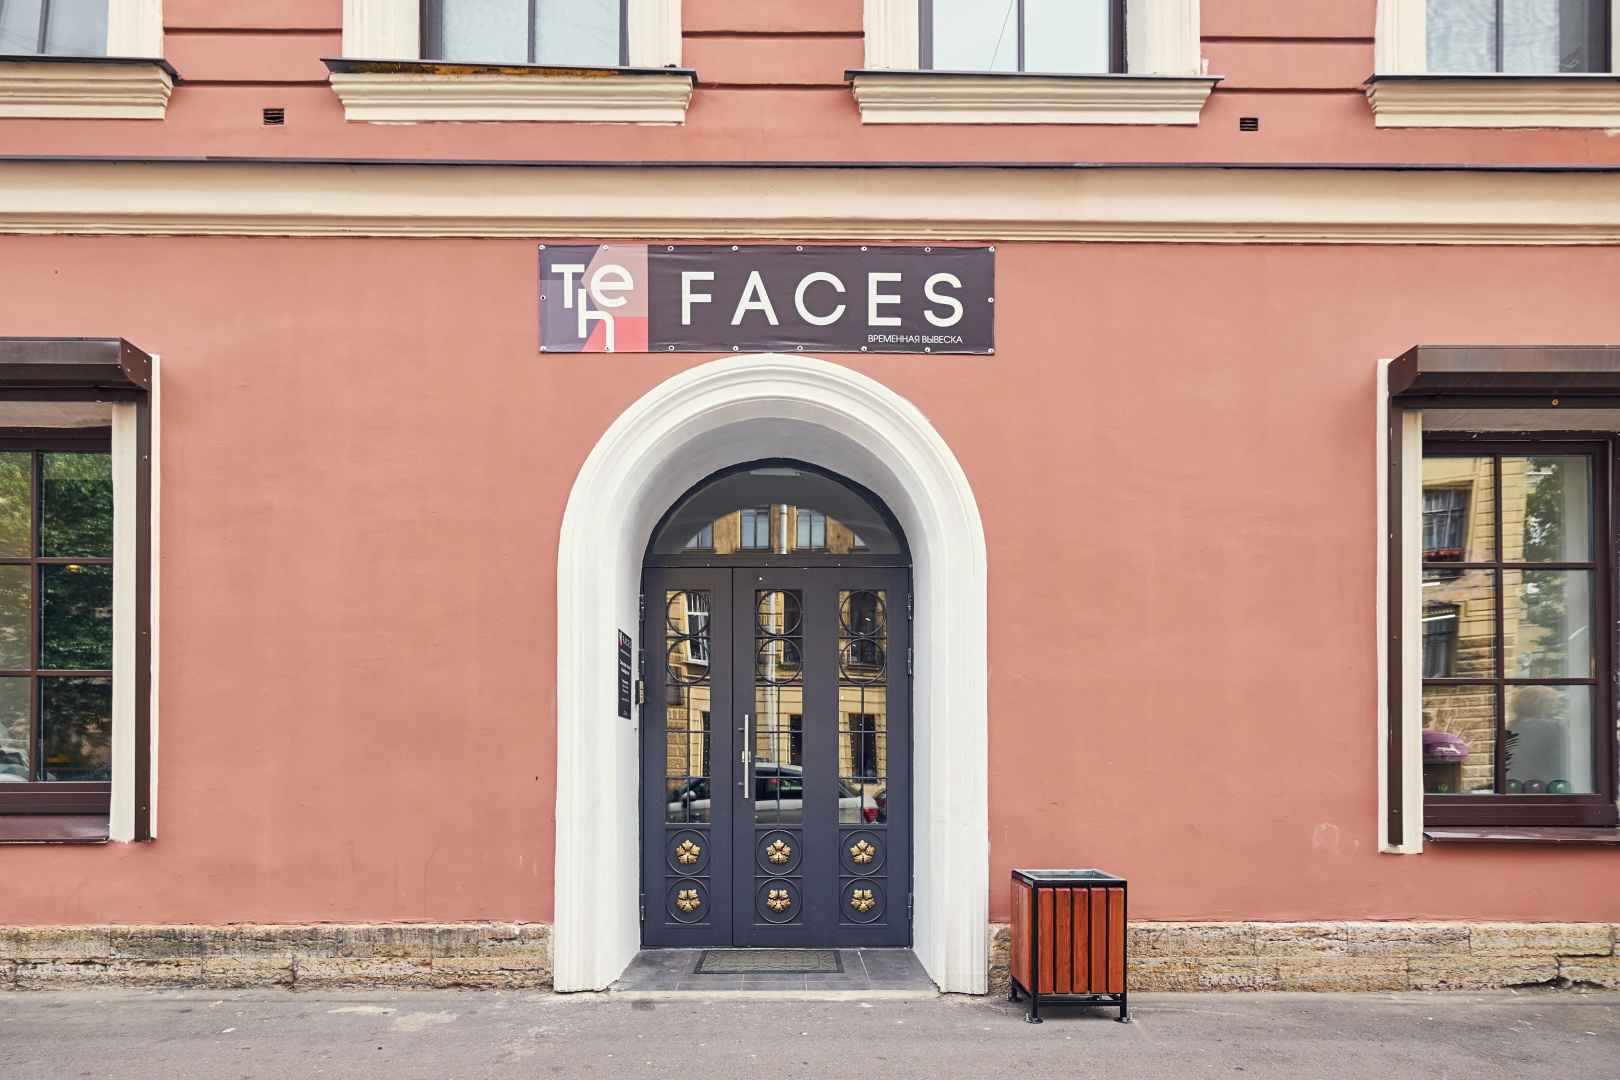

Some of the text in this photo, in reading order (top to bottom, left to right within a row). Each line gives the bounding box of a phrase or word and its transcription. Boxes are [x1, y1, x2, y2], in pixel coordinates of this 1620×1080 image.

[681, 270, 964, 327] FACES
[867, 334, 963, 344] ВРЕМЕННАЯ ВЫВЕСКА
